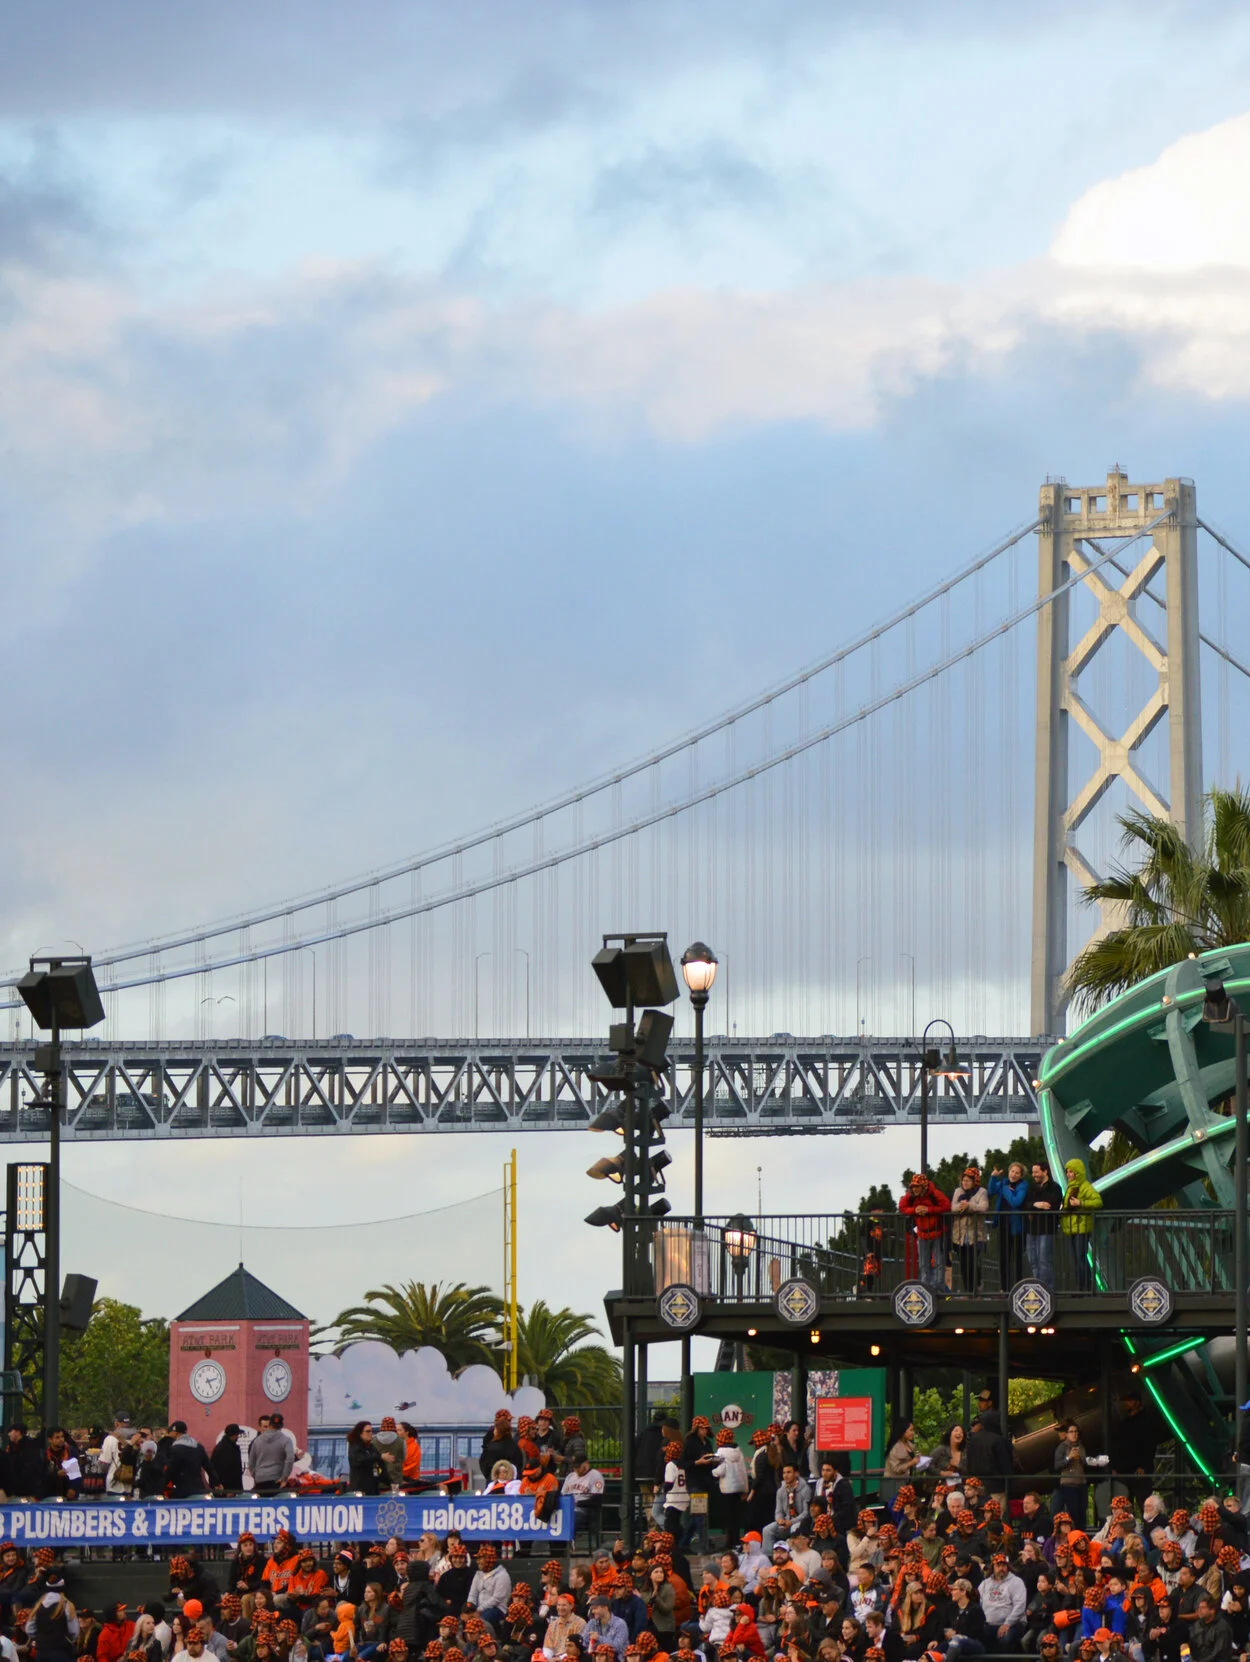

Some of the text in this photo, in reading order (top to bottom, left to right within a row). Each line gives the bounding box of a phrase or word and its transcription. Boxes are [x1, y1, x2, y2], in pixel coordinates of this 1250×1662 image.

[209, 1333, 235, 1345] PARK
[711, 1411, 754, 1426] GIANTS
[11, 1508, 126, 1538] PLUMBERS
[131, 1508, 148, 1537] &
[155, 1506, 290, 1537] PIPEFITTERS
[296, 1504, 364, 1534] UNION
